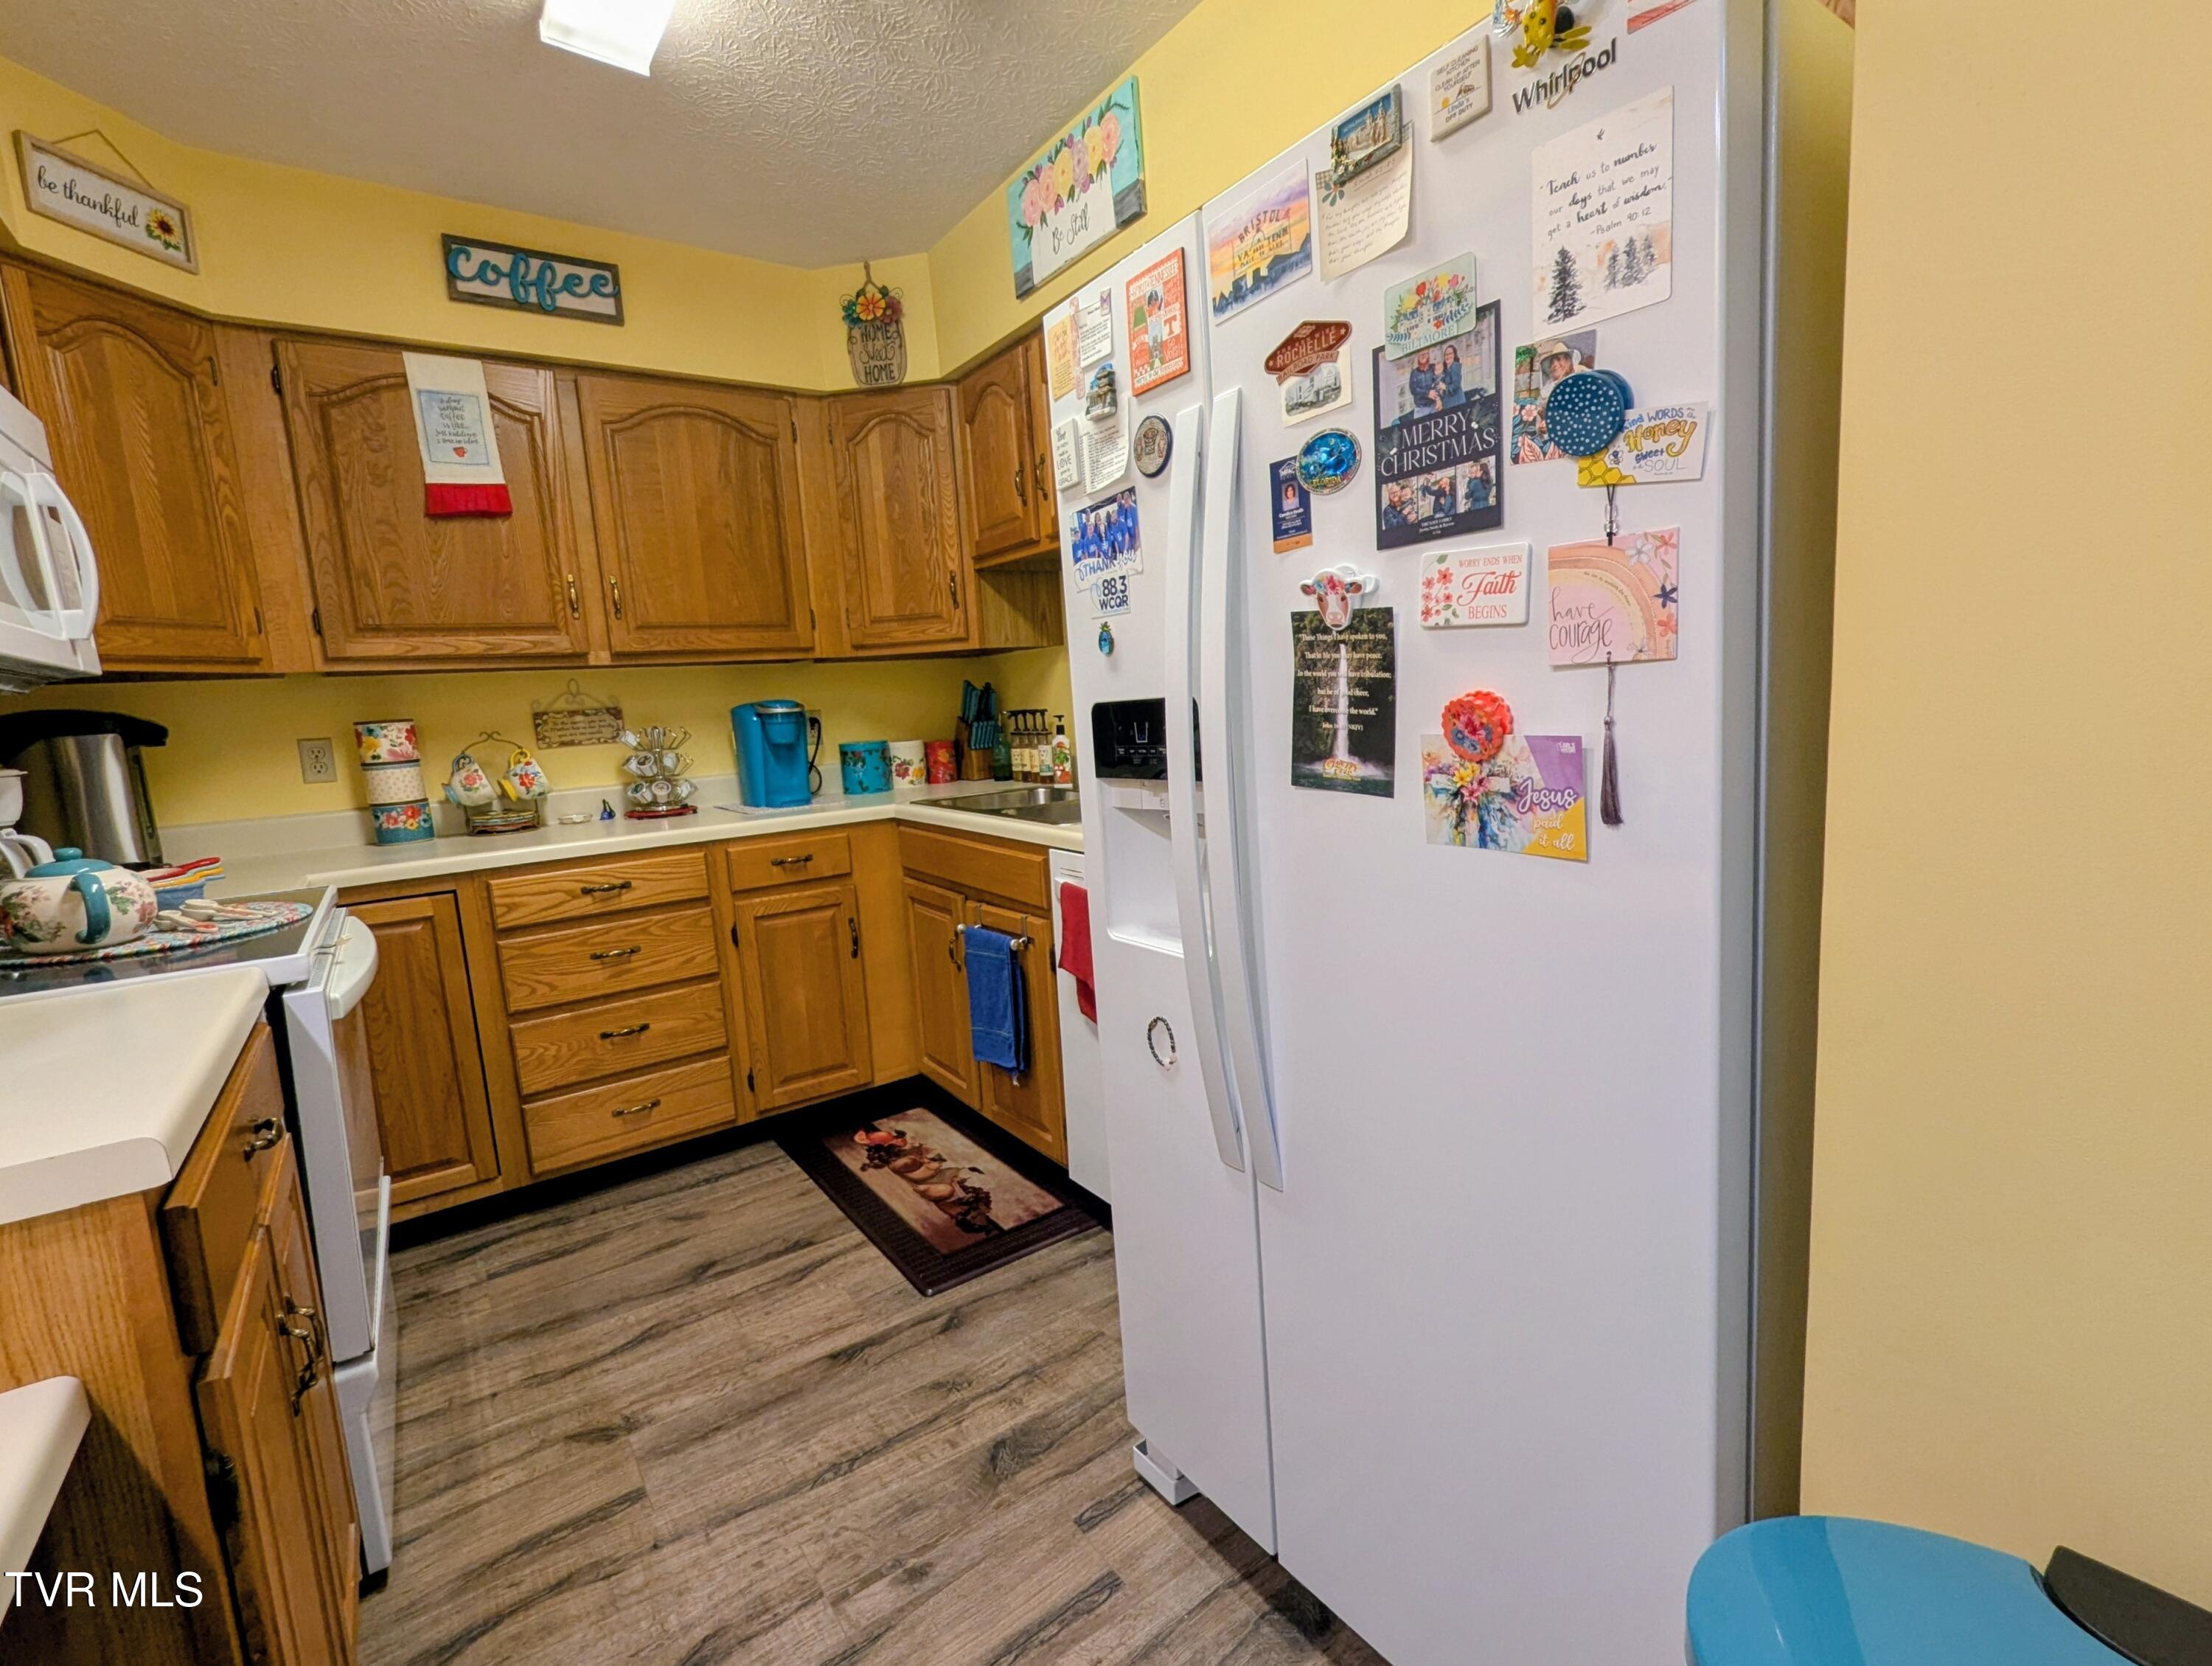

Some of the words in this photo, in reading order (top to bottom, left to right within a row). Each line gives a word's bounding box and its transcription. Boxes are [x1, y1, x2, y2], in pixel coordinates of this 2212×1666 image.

[1512, 37, 1617, 114] Whirlpool
[1586, 170, 1596, 181] us
[1601, 162, 1610, 174] to
[1614, 142, 1658, 167] number
[38, 165, 59, 194] be
[63, 178, 140, 228] thankful
[1549, 206, 1562, 216] our
[1568, 192, 1593, 209] days
[1598, 181, 1616, 195] that
[1622, 176, 1635, 186] we
[1641, 165, 1660, 178] may
[1052, 226, 1065, 255] Be
[1067, 202, 1090, 245] Still
[1239, 209, 1281, 243] BRISTOL
[1548, 223, 1562, 242] get
[1576, 201, 1608, 223] heart
[861, 323, 892, 344] HOME
[1276, 330, 1337, 369] ROCHELLE
[1402, 326, 1457, 355] BILTMORE
[864, 362, 896, 383] HOME
[1279, 356, 1313, 381] RAILROAD
[1316, 353, 1335, 361] PARK
[1402, 409, 1471, 449] MERRY
[1647, 406, 1685, 423] WORDS
[1381, 427, 1496, 477] CHRISTMAS
[1623, 419, 1698, 458] Honey
[1635, 448, 1665, 465] sweet
[1644, 457, 1688, 473] SOUL
[1312, 476, 1342, 486] FLORIDA
[1082, 558, 1116, 577] THANK
[1458, 558, 1481, 568] WORRY
[1484, 556, 1500, 566] ENDS
[1502, 554, 1523, 564] WHEN
[1099, 594, 1130, 611] WCQR
[1456, 570, 1523, 607] Faith
[1548, 586, 1614, 622] have
[1468, 605, 1508, 619] BEGINS
[1549, 619, 1613, 664] courage
[1518, 778, 1577, 812] Jesus
[1533, 813, 1563, 833] paid
[1540, 834, 1550, 847] it
[1553, 833, 1575, 850] all
